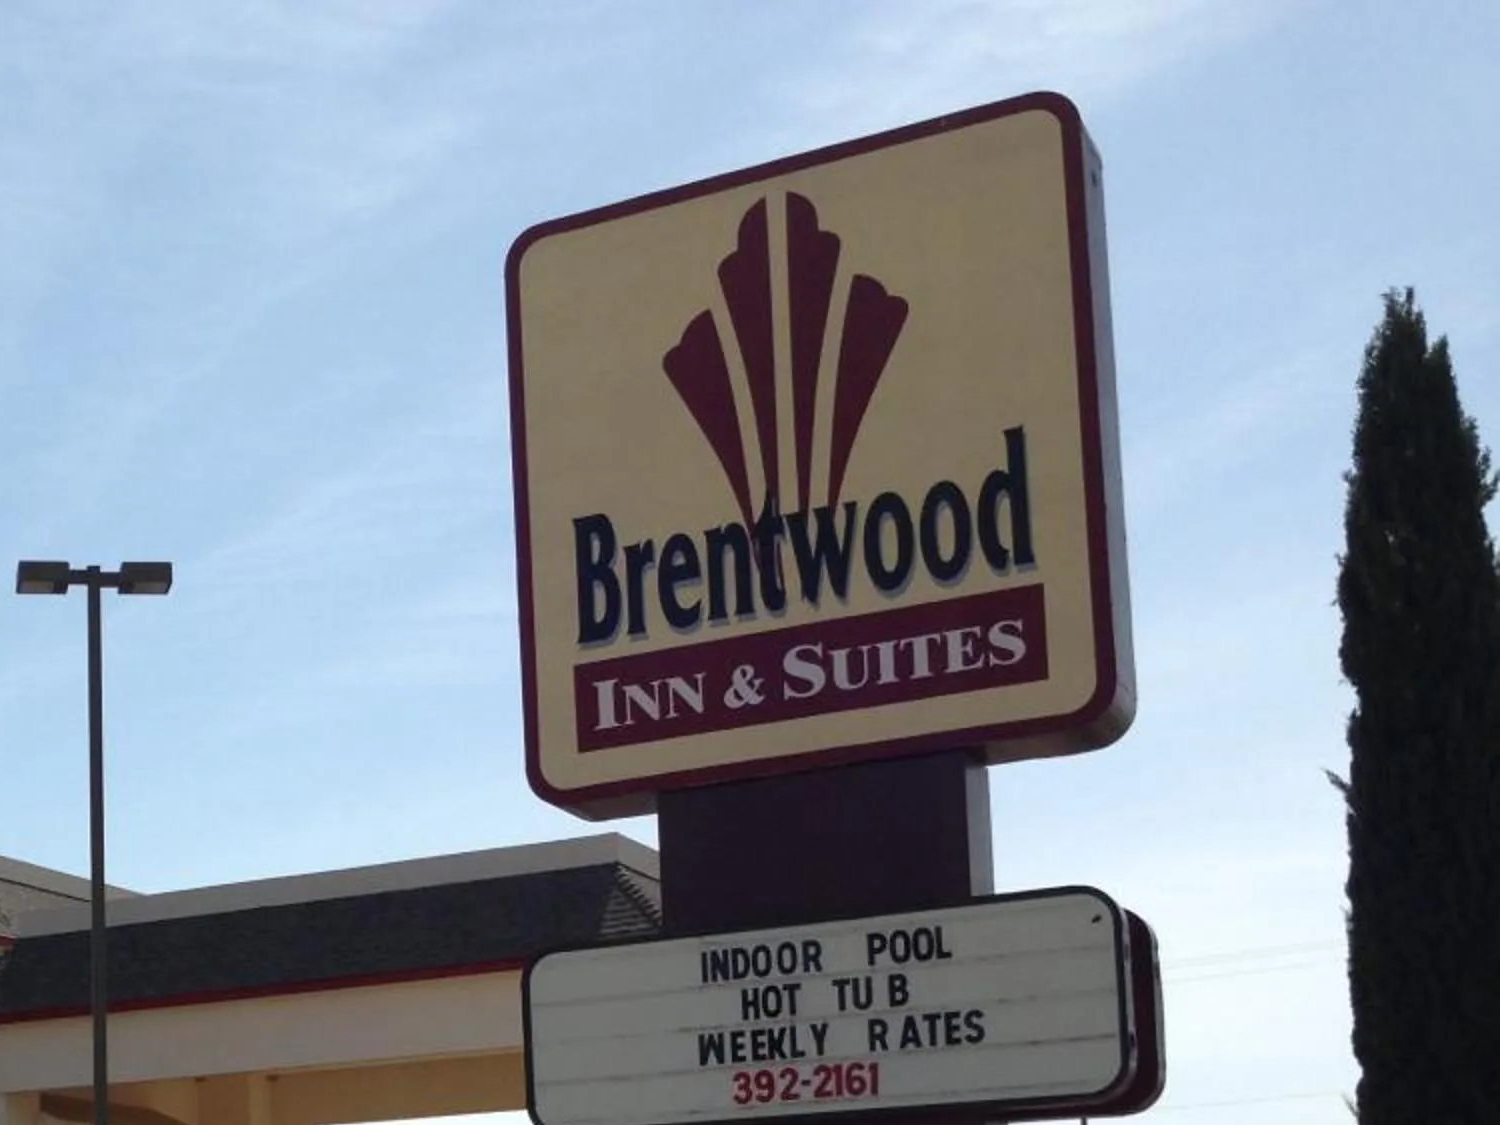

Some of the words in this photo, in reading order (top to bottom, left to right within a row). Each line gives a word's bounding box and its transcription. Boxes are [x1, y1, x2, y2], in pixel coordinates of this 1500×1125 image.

[573, 425, 1035, 645] Brentwood
[723, 664, 766, 709] &
[701, 942, 823, 983] INDOOR
[867, 926, 953, 966] POOL
[741, 984, 801, 1021] HOT
[699, 1023, 829, 1066] WEEKLY
[868, 1009, 986, 1051] RATES
[733, 1062, 879, 1105] 392-2161
